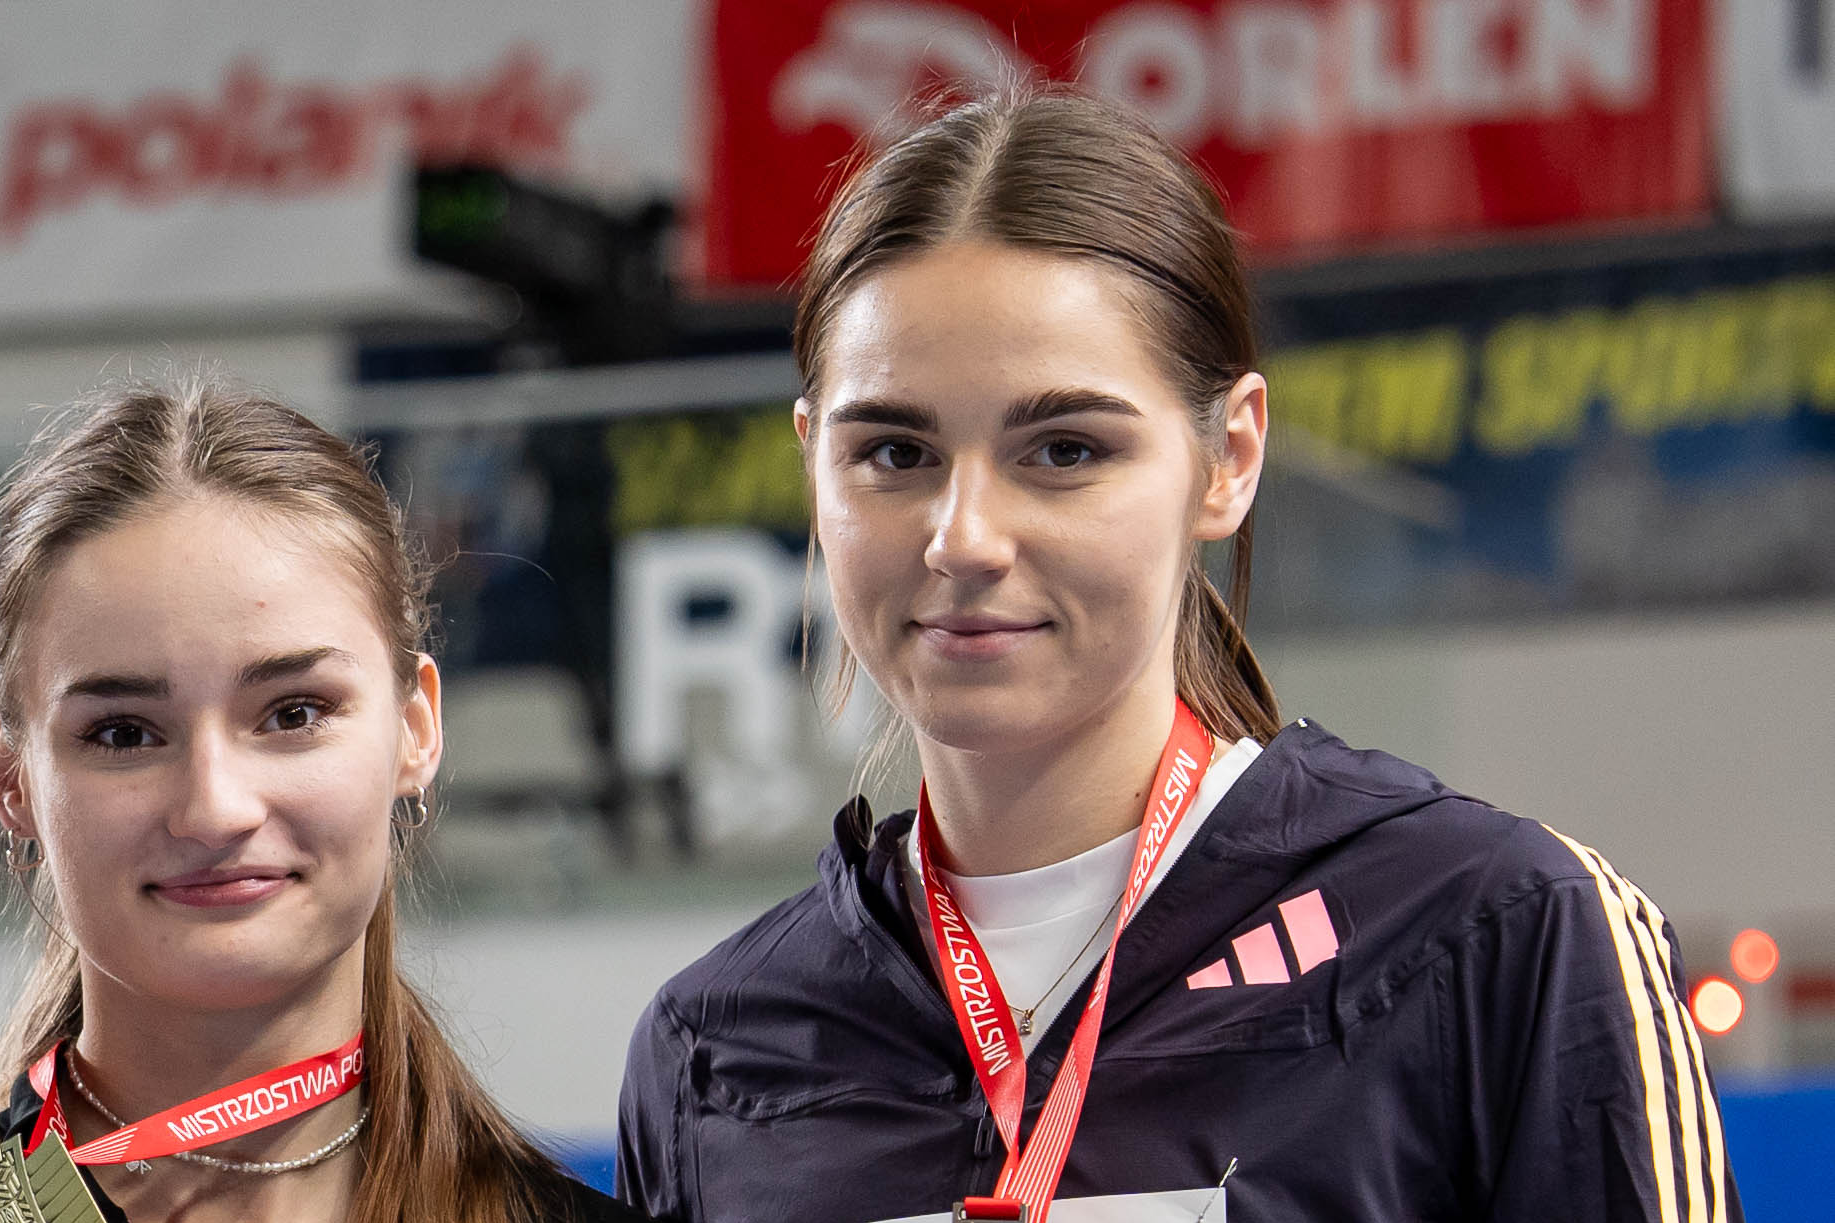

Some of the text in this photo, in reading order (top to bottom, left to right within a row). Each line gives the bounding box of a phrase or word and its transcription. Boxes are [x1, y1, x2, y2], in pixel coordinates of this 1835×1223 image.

[1086, 0, 1656, 152] ORLEN
[933, 892, 1012, 1077] MISTRZOSTWA
[167, 1047, 363, 1143] MISTRZOSTWA PO
